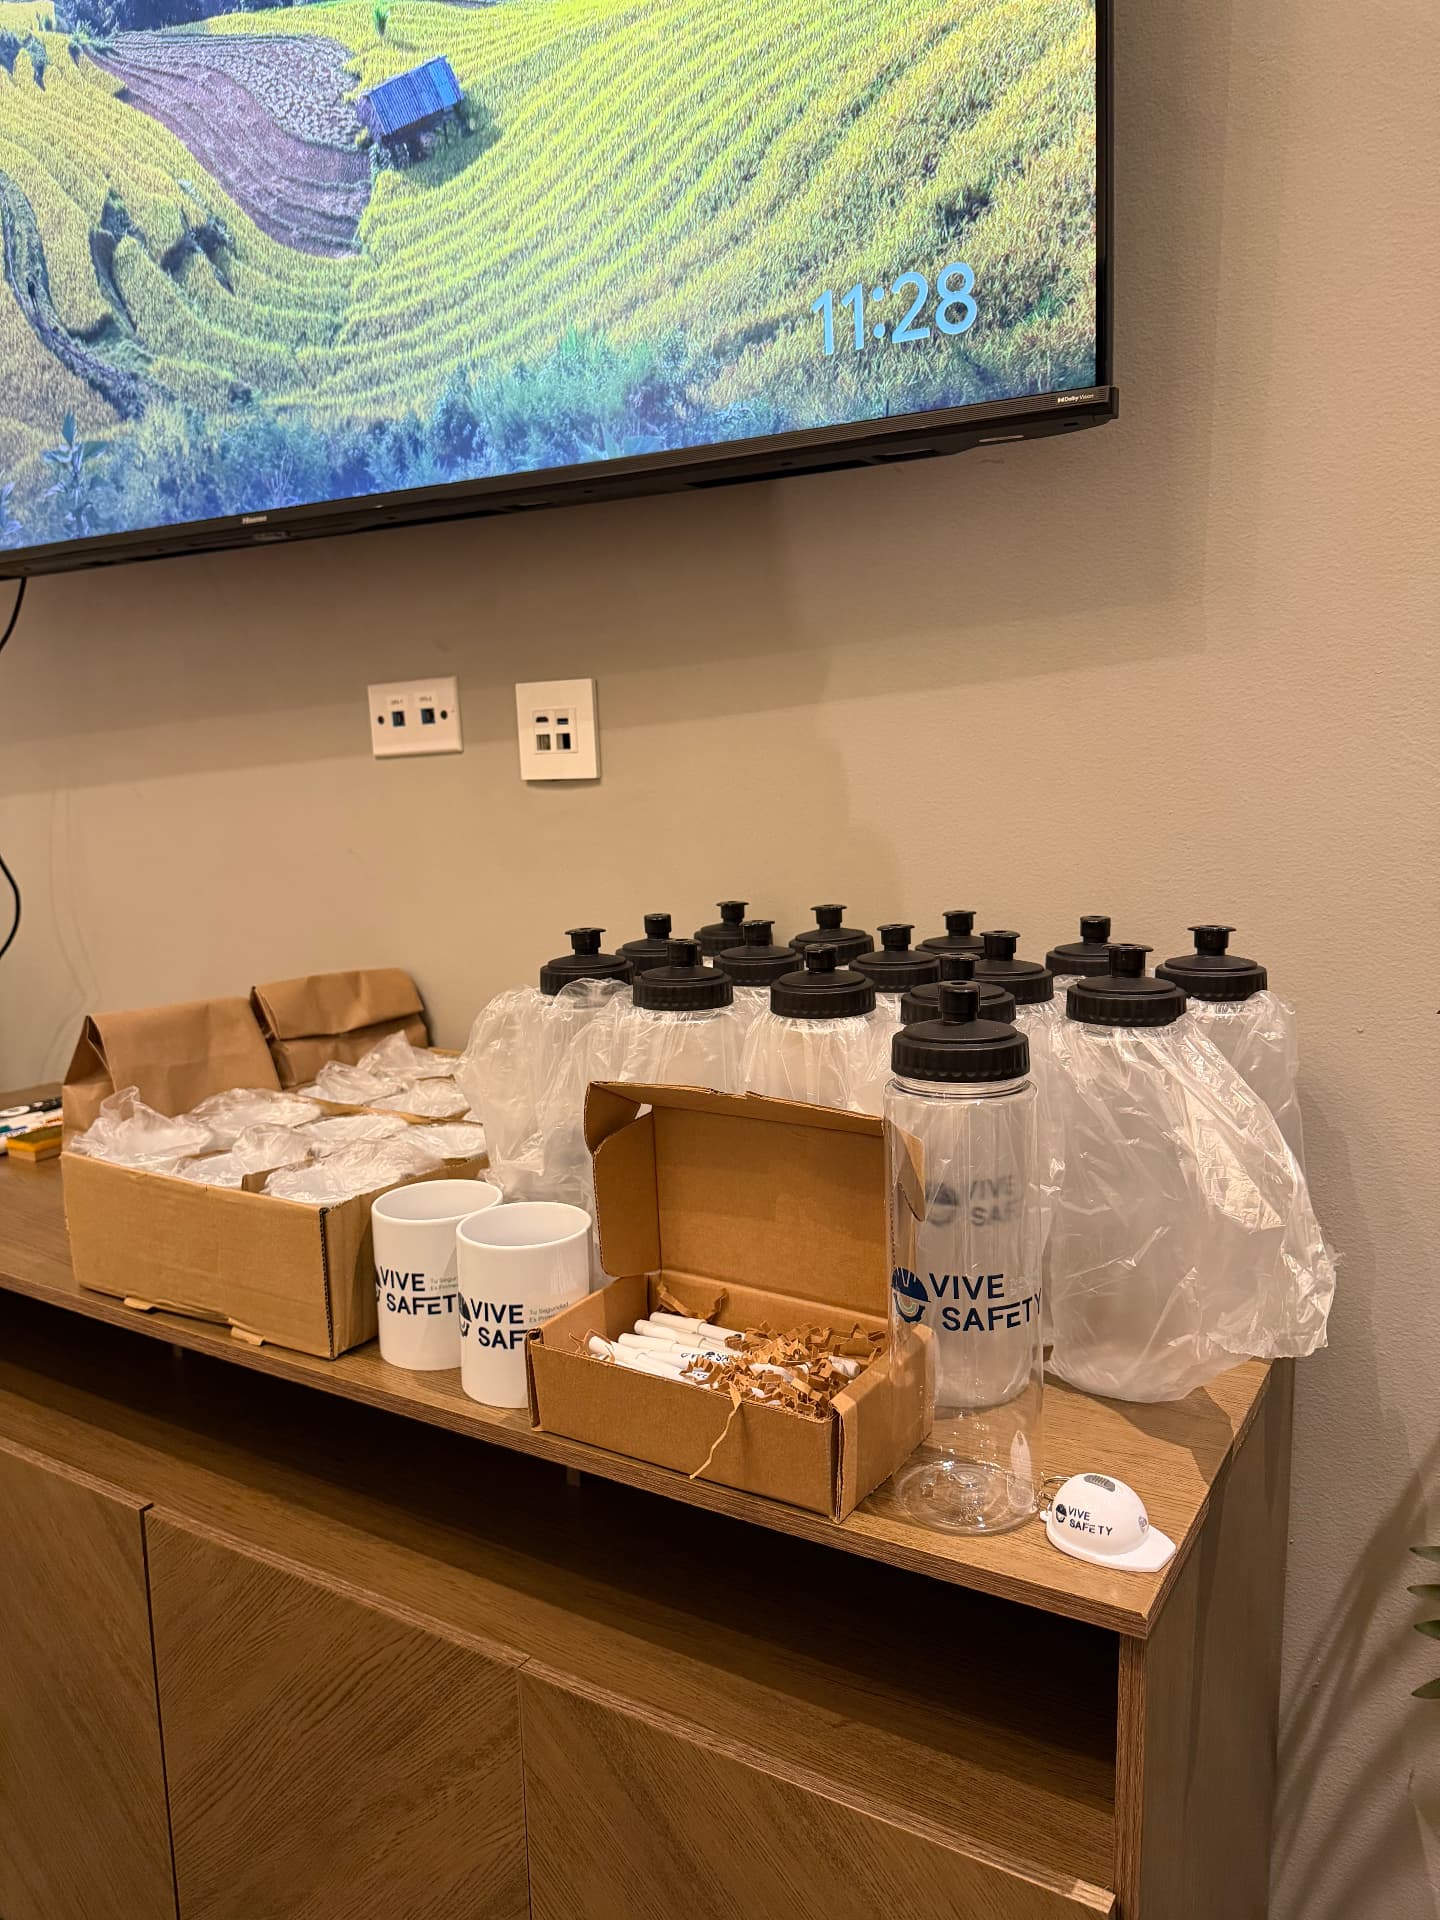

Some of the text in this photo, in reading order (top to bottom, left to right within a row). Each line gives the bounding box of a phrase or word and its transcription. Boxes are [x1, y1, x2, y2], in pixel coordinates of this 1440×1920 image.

[811, 261, 978, 356] 11:28
[379, 1266, 425, 1292] VIVE
[928, 1272, 1005, 1300] VIVE
[386, 1293, 457, 1315] SAFET
[470, 1298, 524, 1324] VIVE
[942, 1288, 1042, 1331] SAFETY
[1068, 1505, 1091, 1521] VIVE
[1069, 1518, 1113, 1536] SAFETY
